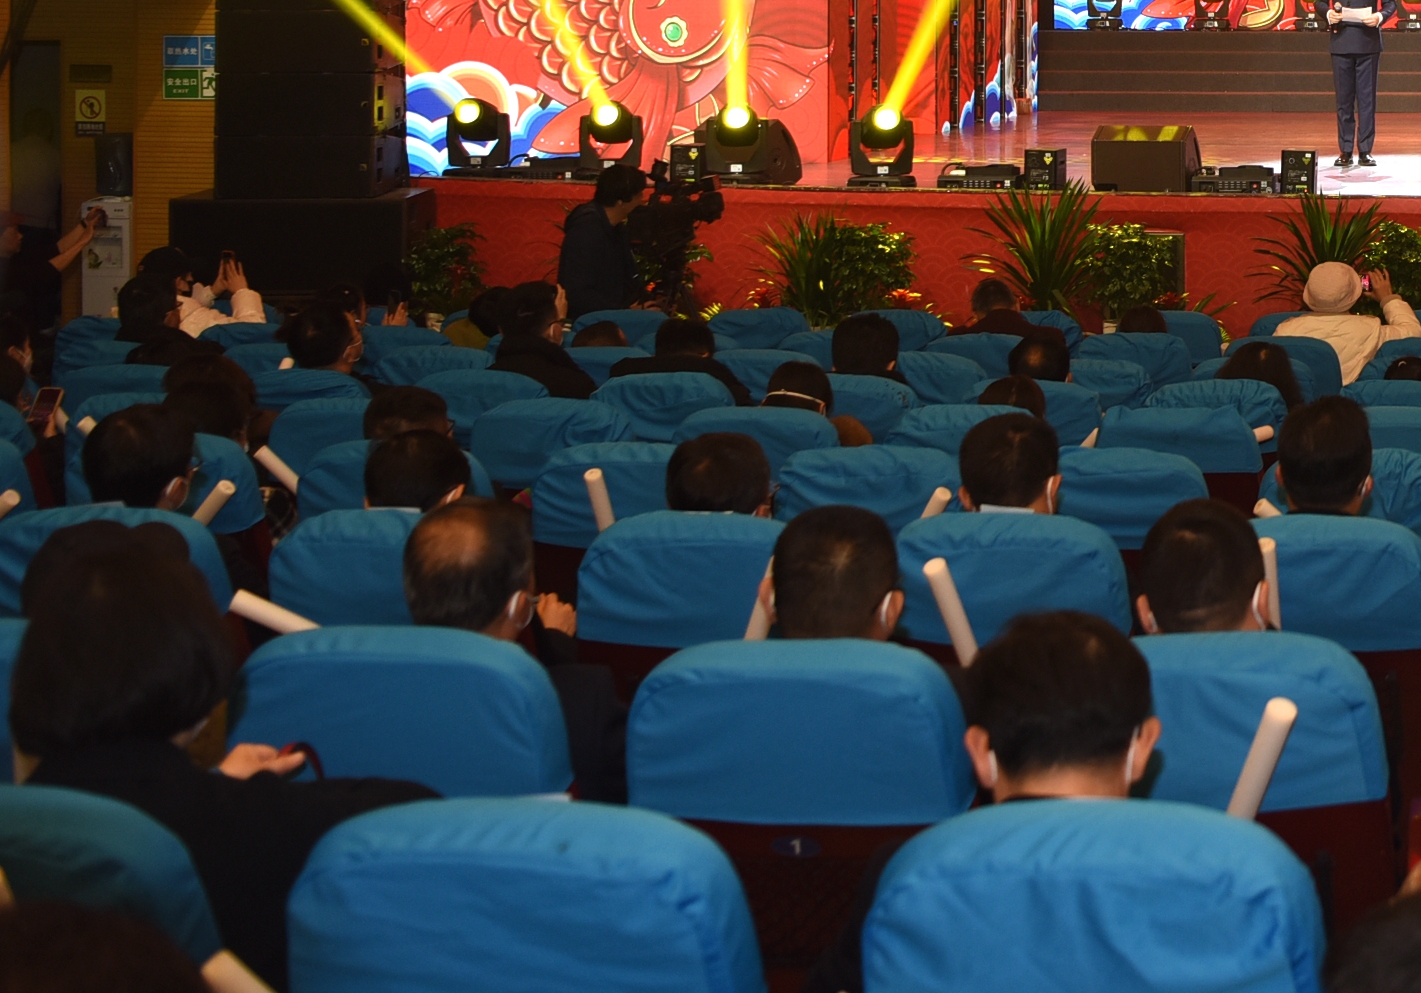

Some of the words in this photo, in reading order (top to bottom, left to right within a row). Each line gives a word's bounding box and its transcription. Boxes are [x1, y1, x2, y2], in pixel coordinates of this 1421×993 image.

[166, 77, 198, 86] 安全出口
[790, 837, 802, 855] 1
